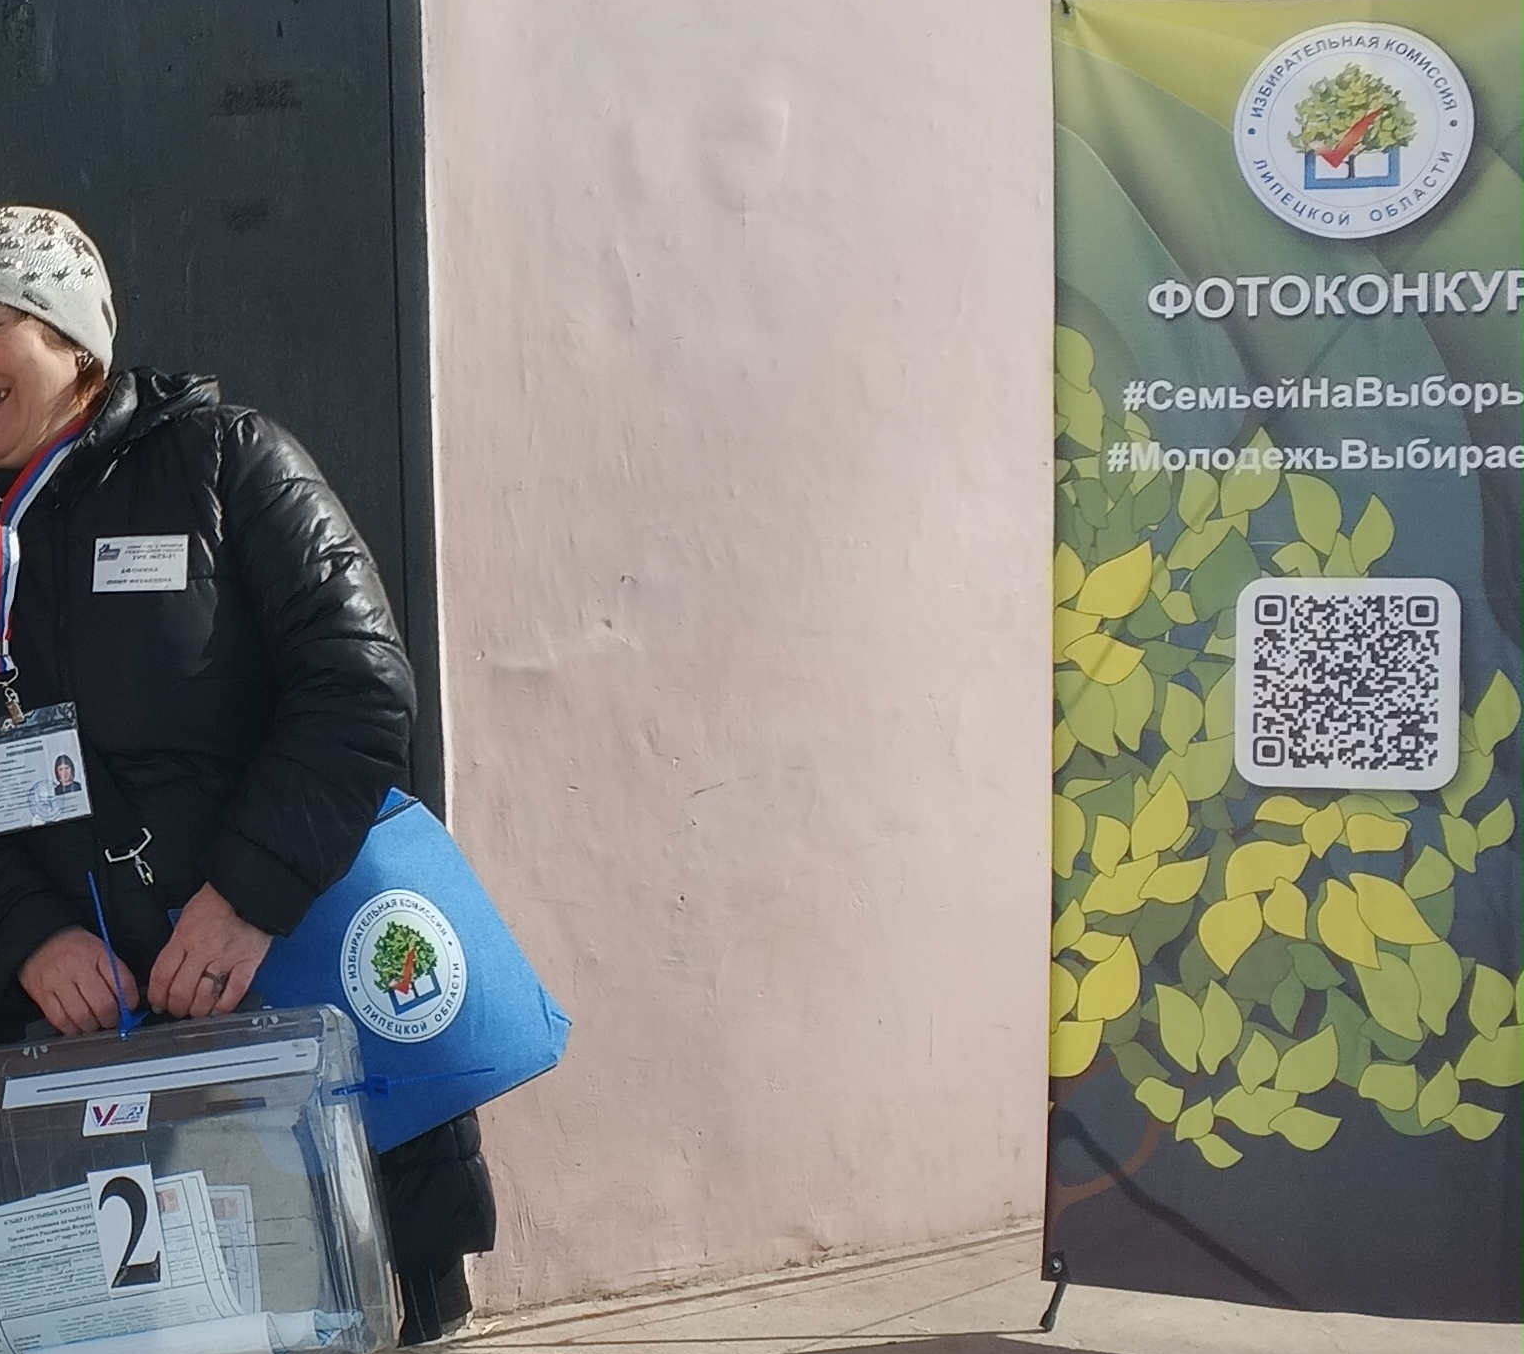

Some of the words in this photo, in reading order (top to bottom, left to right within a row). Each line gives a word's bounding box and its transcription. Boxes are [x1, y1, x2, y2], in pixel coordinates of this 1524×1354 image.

[1251, 35, 1381, 119] ИЗБИРАТЕЛЬНАЯ
[1384, 37, 1458, 112] КОМИССИЯ
[1254, 158, 1351, 227] ЛИПЕЦКОЙ
[1369, 149, 1454, 223] ОБЛАСТИ
[347, 898, 398, 980] ИЗБИРАТЕЛЬНАЯ
[362, 1003, 428, 1036] ЛИПЕЦКОЙ
[434, 962, 460, 1023] ОБЛАСТИ
[97, 1175, 161, 1289] 2
